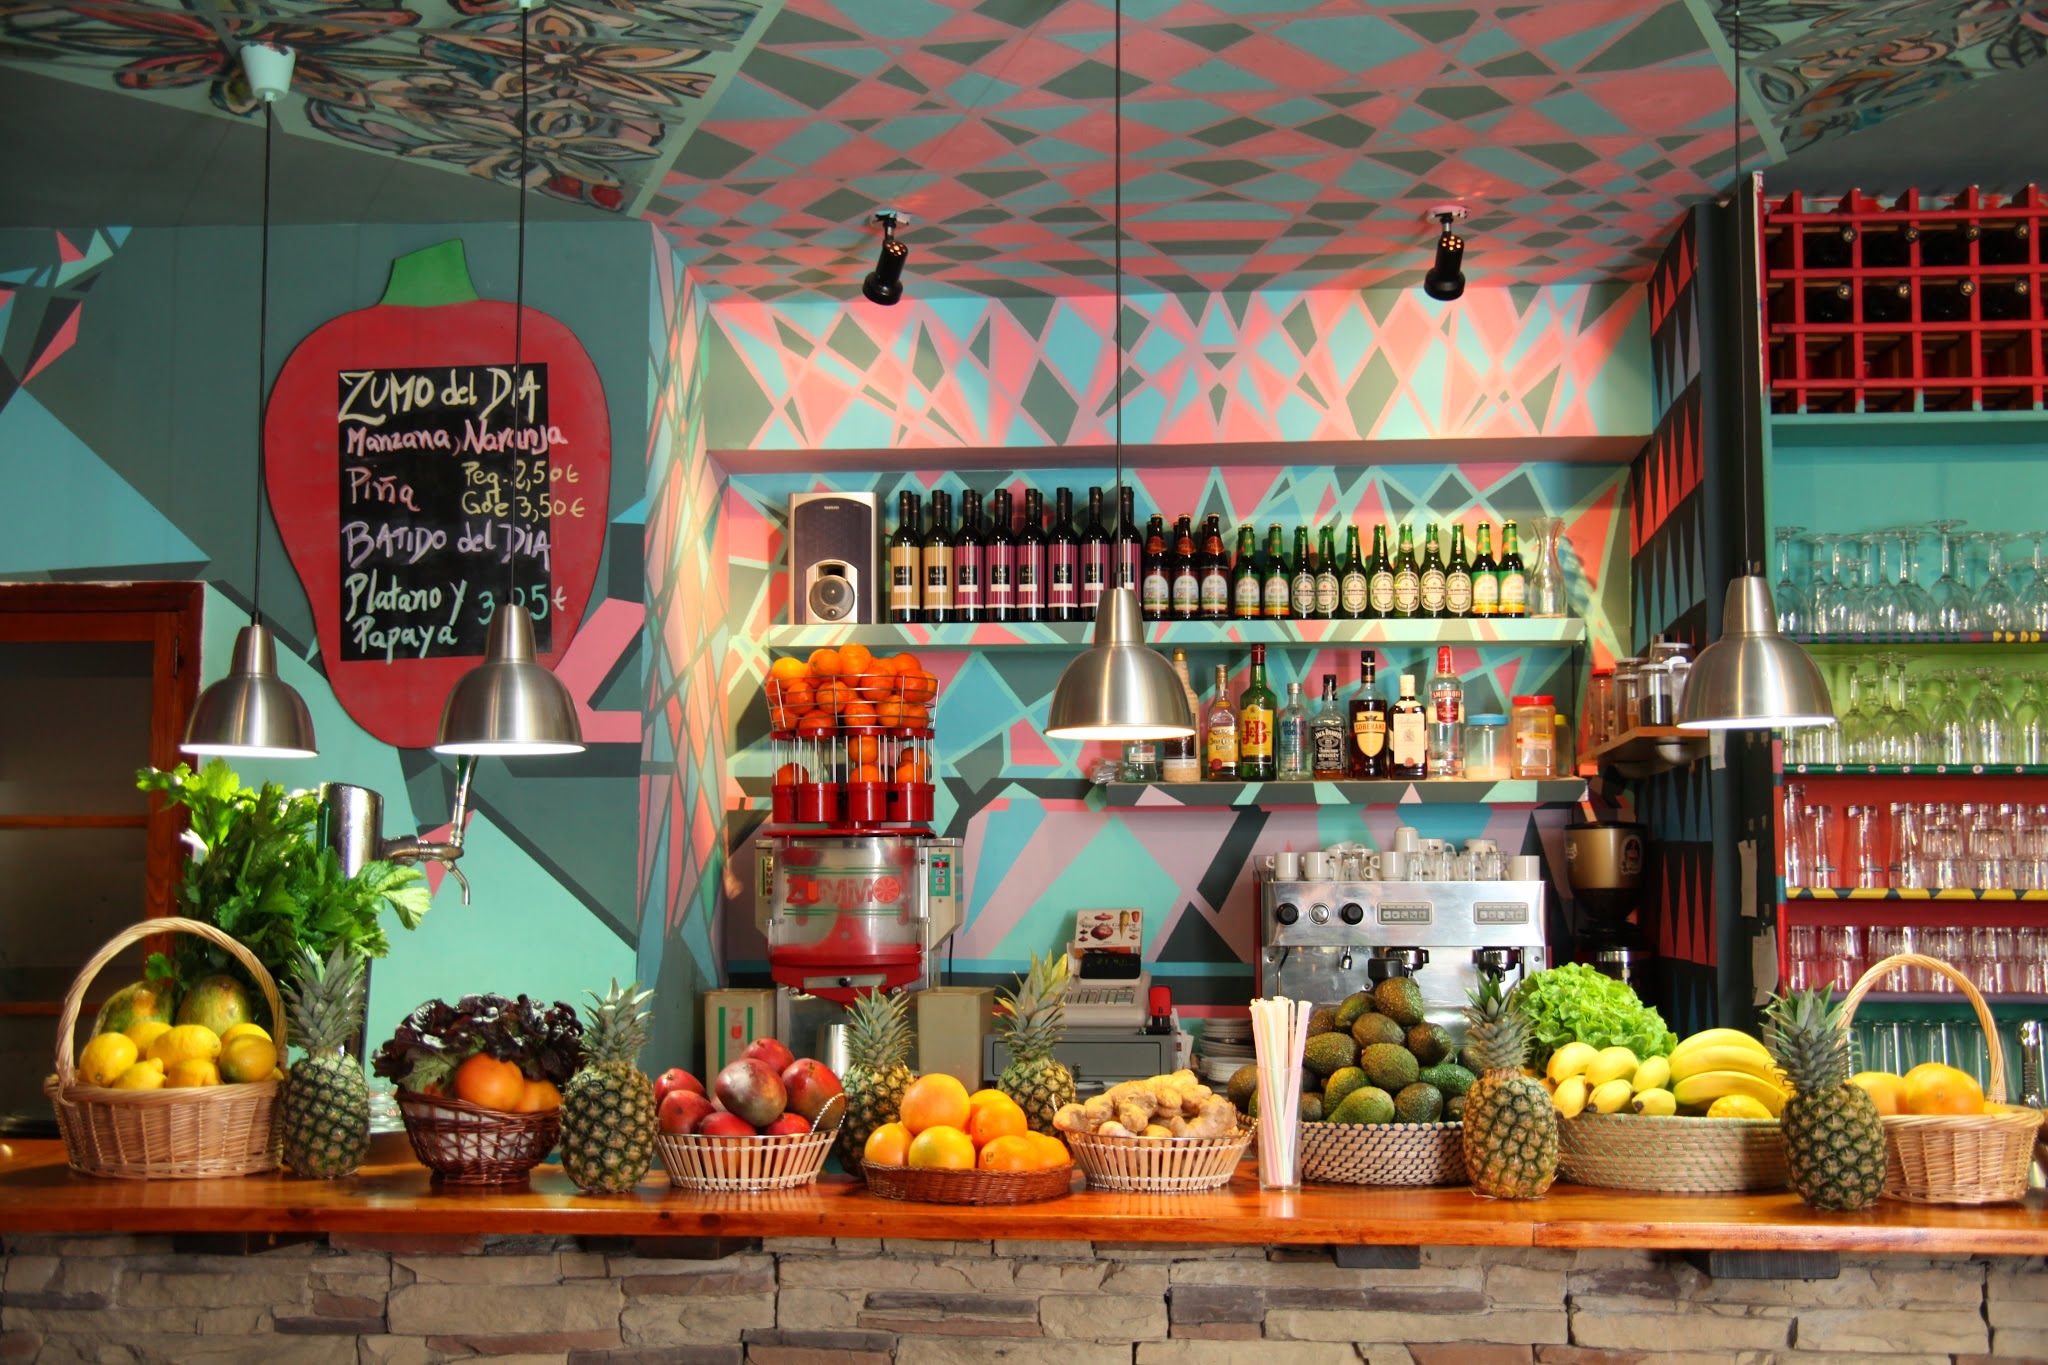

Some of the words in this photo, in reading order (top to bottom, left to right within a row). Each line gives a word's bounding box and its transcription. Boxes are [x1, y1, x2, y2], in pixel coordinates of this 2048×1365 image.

[338, 371, 435, 426] ZUMO
[441, 368, 478, 406] del
[463, 418, 568, 455] Naranja
[345, 465, 420, 512] Piña
[341, 521, 447, 569] BATIDO
[457, 519, 497, 554] del
[345, 568, 442, 622] Platano
[352, 615, 459, 665] Papaya
[1242, 720, 1267, 745] J&B
